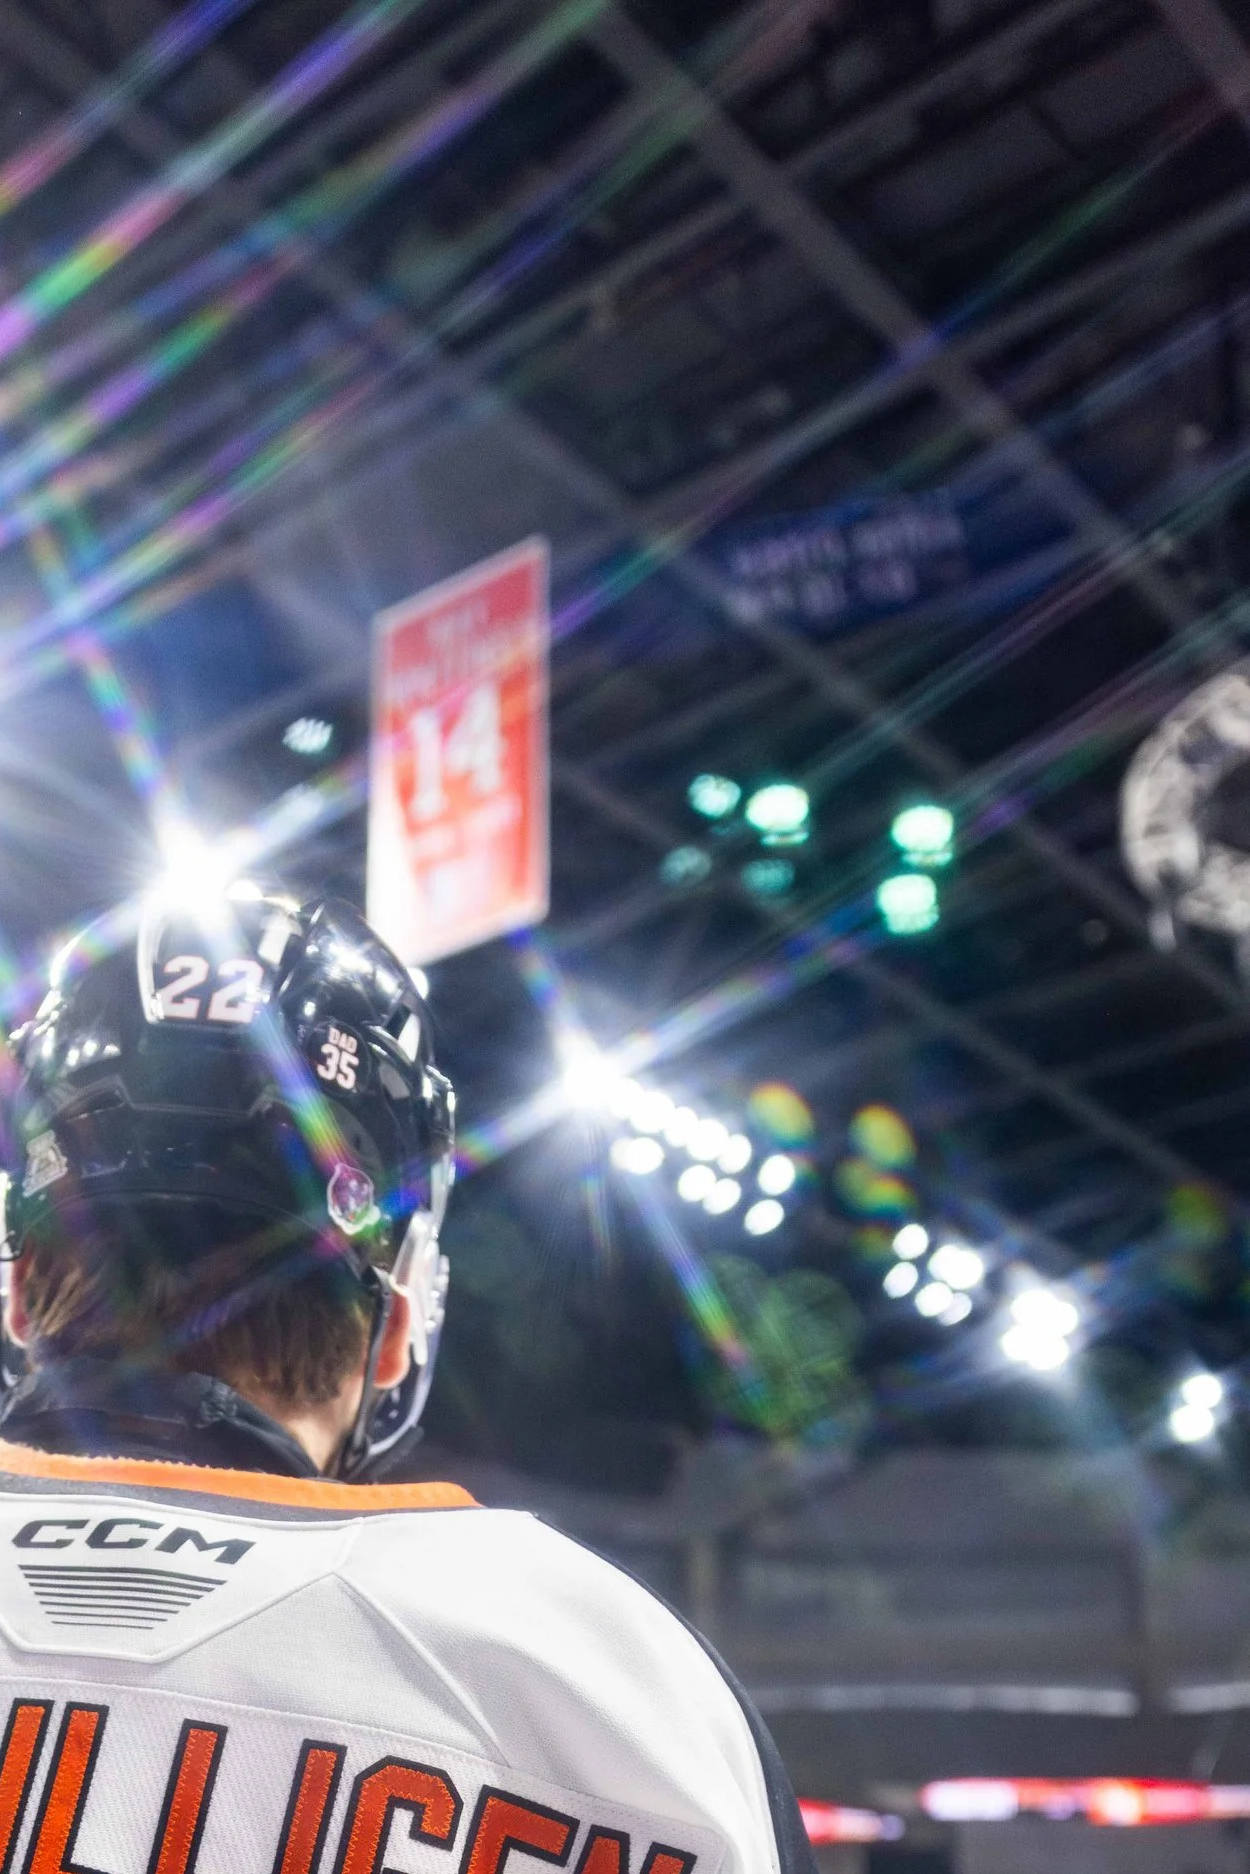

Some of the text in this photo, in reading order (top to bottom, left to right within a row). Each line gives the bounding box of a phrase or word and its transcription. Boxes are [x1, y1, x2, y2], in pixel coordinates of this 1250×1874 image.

[410, 683, 506, 821] 14
[157, 955, 264, 1023] 22
[328, 1026, 358, 1053] DAD
[317, 1043, 360, 1089] 35
[11, 1517, 257, 1566] CCM
